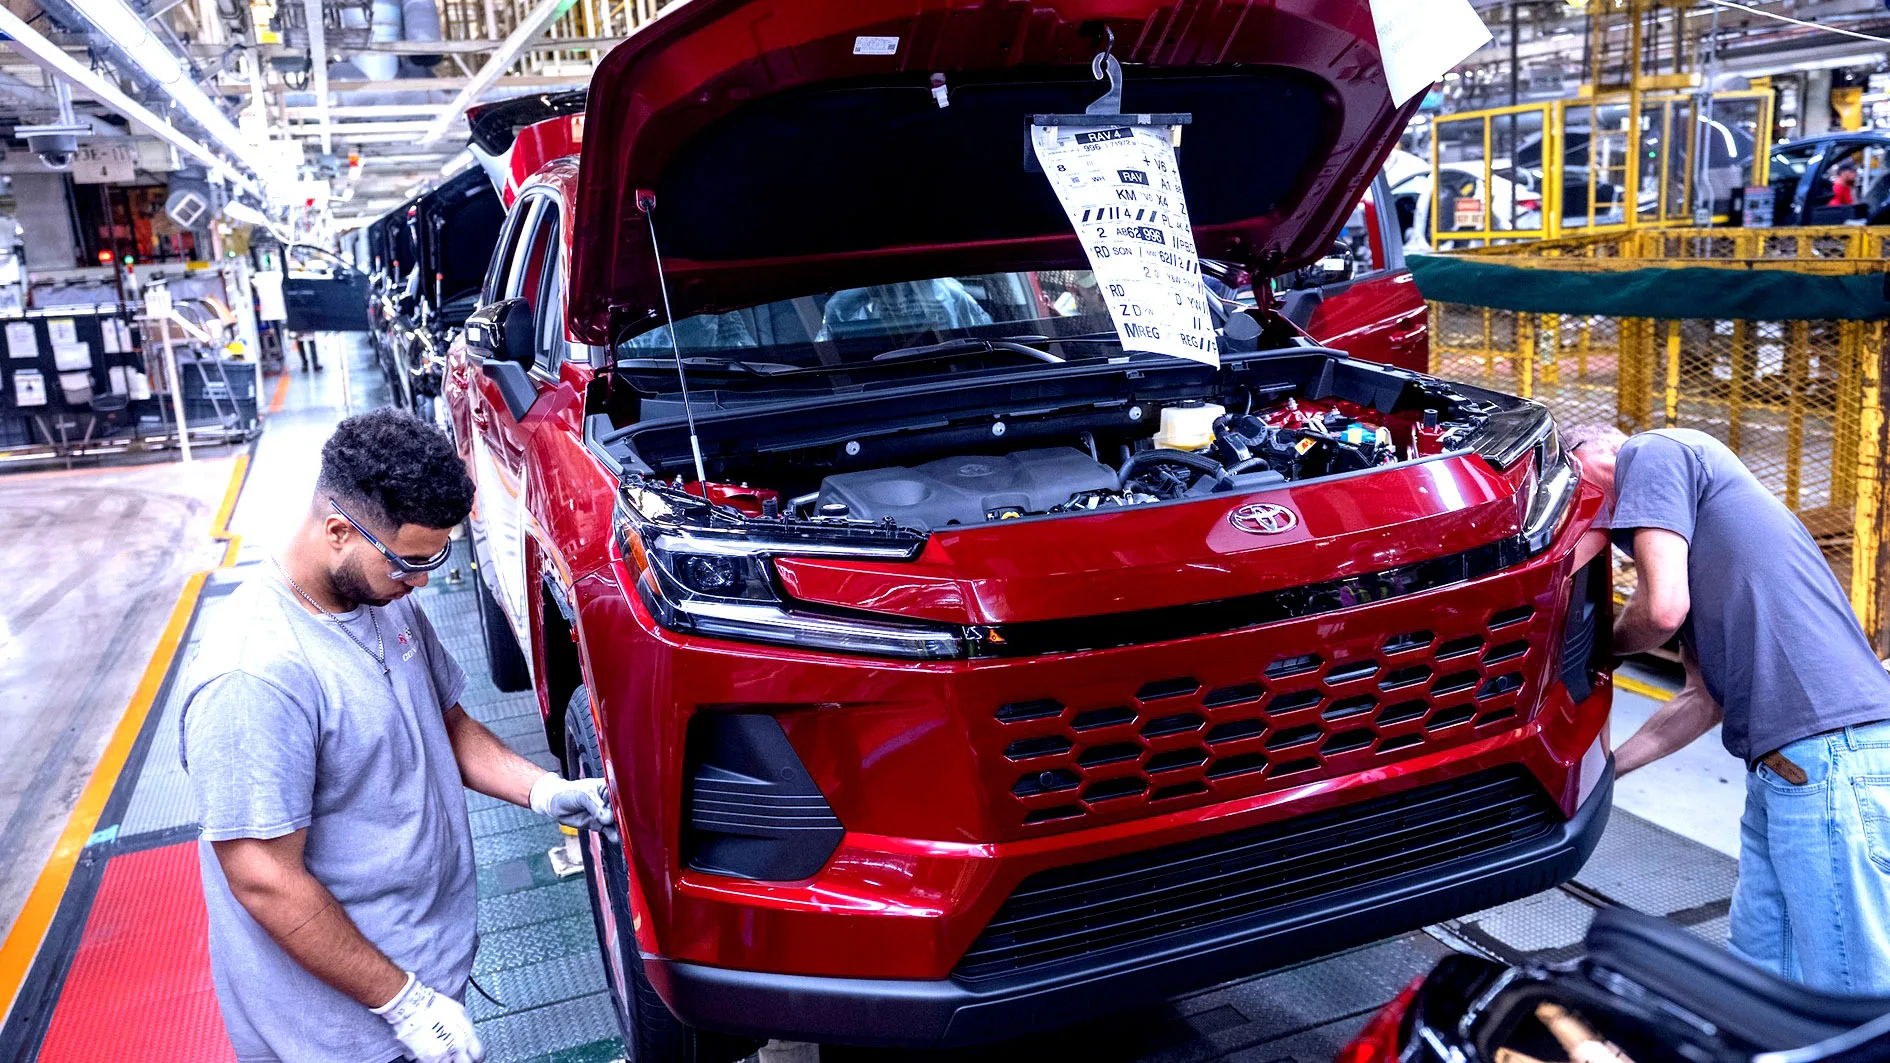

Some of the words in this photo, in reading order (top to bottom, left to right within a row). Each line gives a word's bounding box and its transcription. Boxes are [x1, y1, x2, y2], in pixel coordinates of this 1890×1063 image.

[1088, 131, 1111, 142] RAV
[1084, 144, 1102, 152] 996
[1057, 164, 1066, 172] 8
[1154, 158, 1167, 172] V6
[1123, 172, 1142, 182] RAV
[1116, 189, 1137, 200] KM
[1156, 194, 1168, 207] X4
[1124, 208, 1132, 218] 4
[1096, 228, 1108, 238] 2
[1142, 228, 1162, 242] 996
[1094, 246, 1110, 258] RD
[1112, 246, 1132, 256] SON
[1144, 266, 1152, 278] 2
[1109, 284, 1125, 297] RD
[1119, 304, 1130, 316] Z
[1180, 333, 1198, 348] REG
